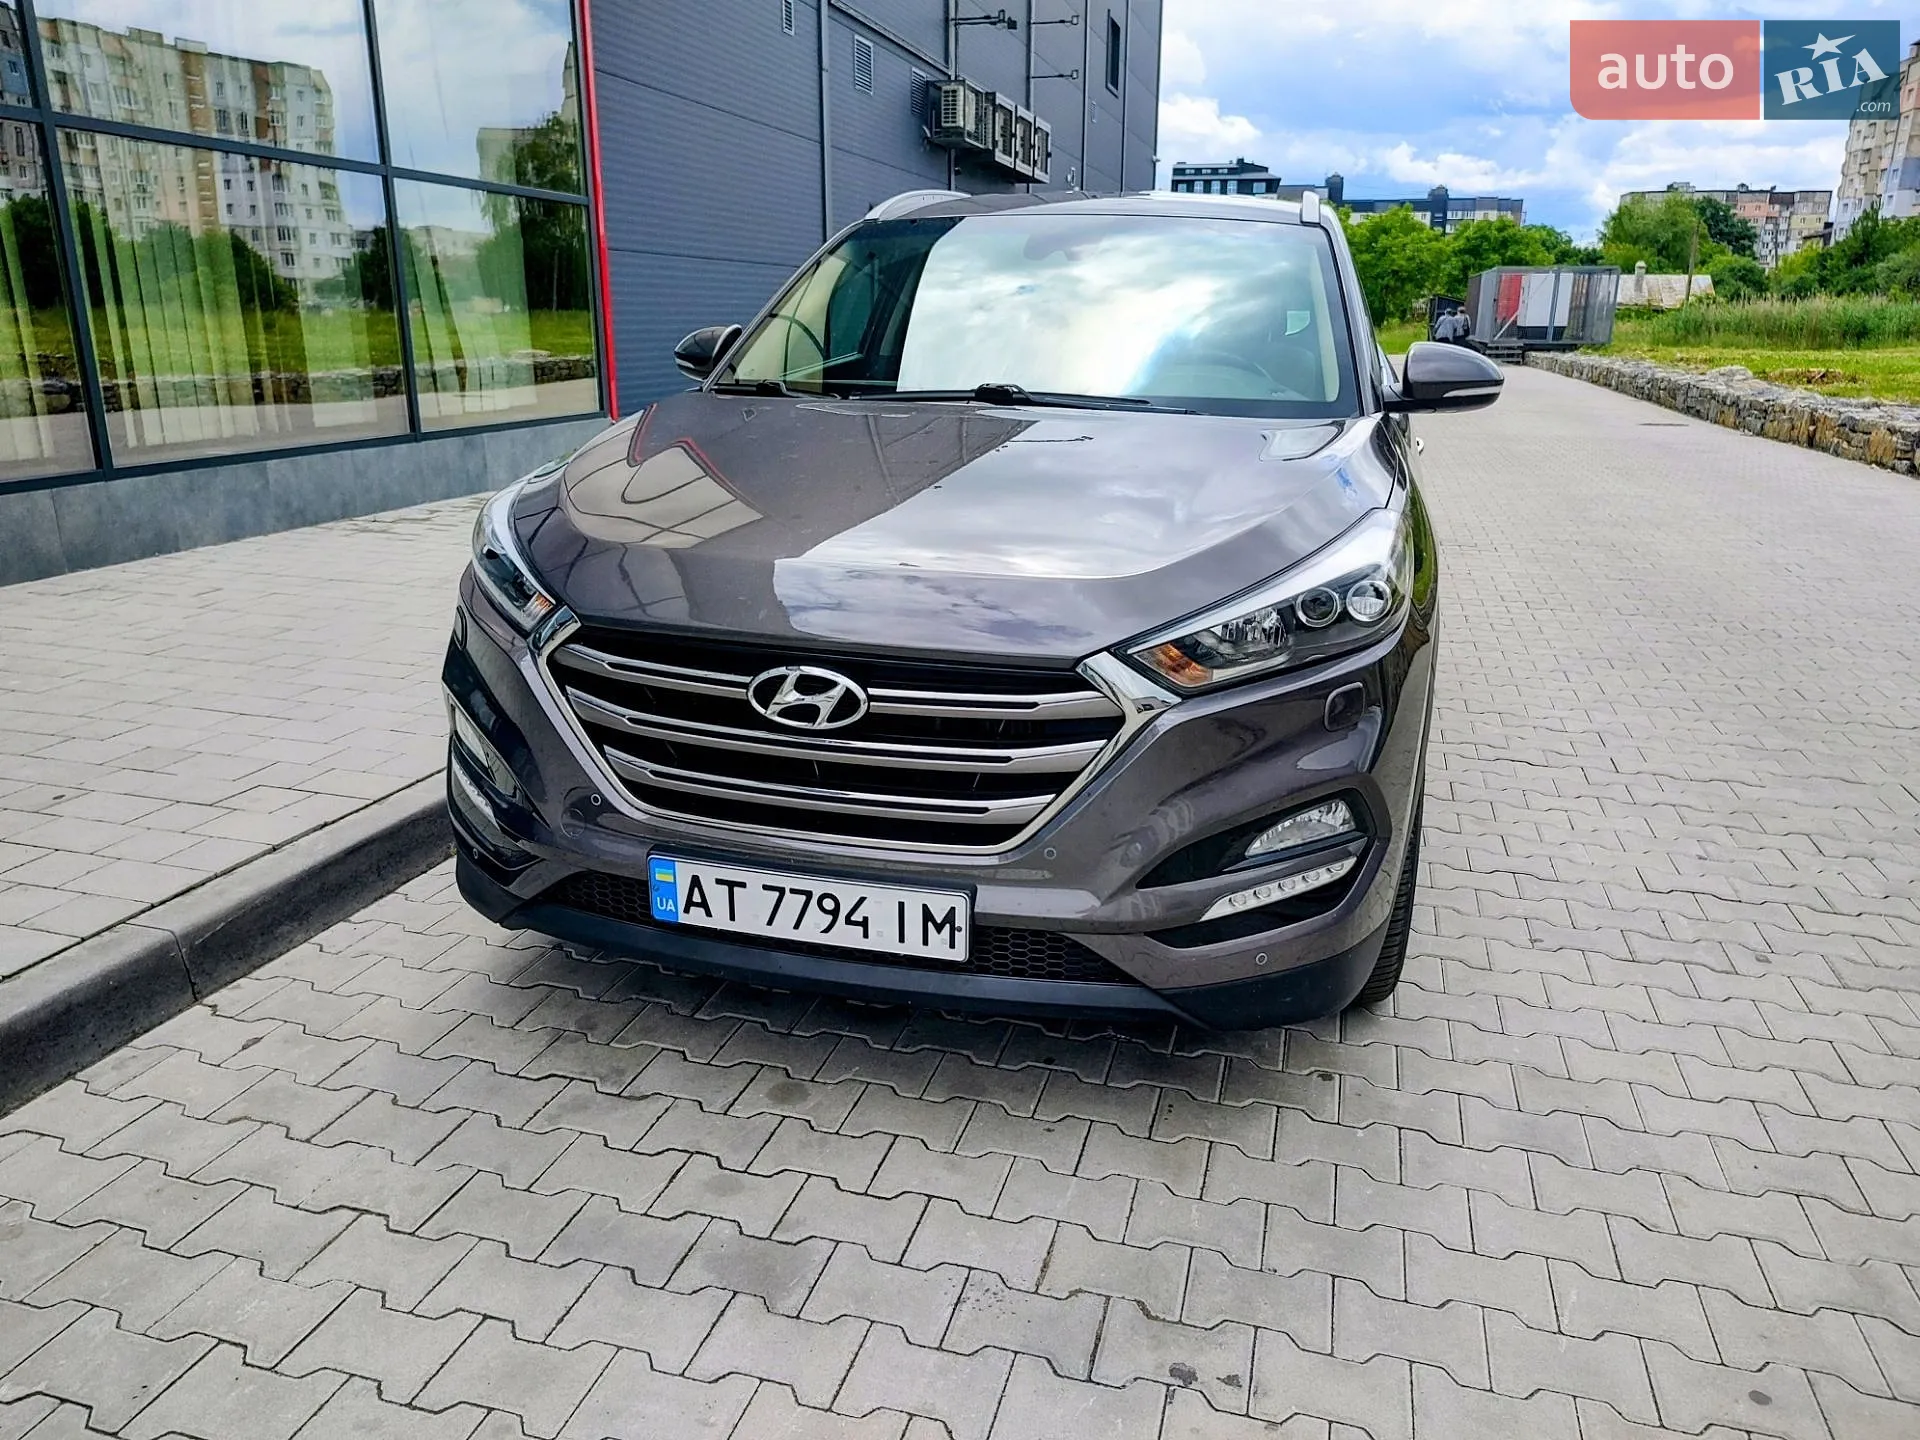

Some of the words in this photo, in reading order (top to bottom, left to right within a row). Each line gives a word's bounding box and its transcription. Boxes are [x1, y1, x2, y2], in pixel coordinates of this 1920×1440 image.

[656, 896, 677, 913] UA
[682, 874, 748, 922] AT
[761, 884, 870, 940] 7794
[897, 900, 957, 950] IM
